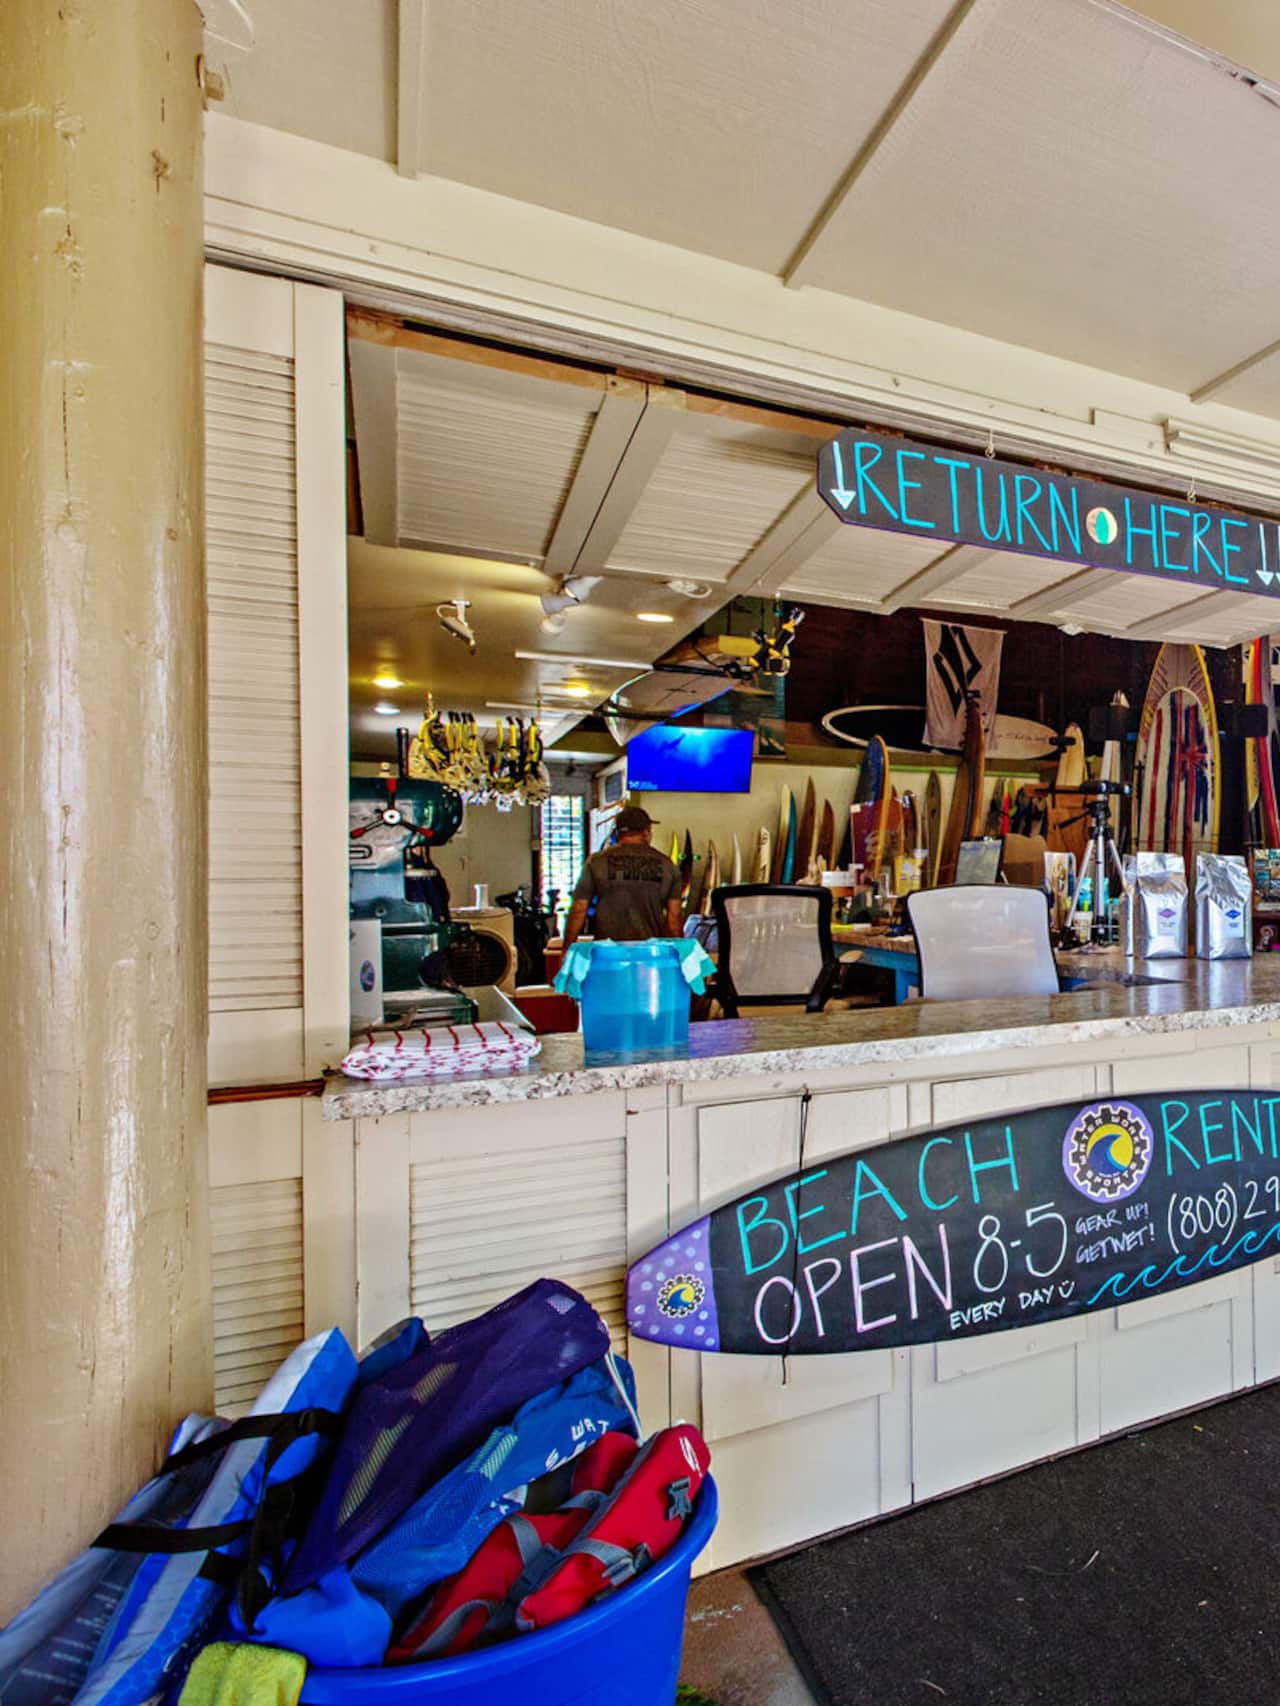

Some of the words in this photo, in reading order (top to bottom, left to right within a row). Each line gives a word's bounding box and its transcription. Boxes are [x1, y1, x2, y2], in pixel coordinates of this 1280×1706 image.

[855, 441, 1082, 556] RETURN
[1125, 497, 1250, 584] HERE
[736, 1125, 1019, 1276] BEACH
[1075, 1209, 1122, 1236] GEAR
[1126, 1202, 1149, 1221] UP!
[1167, 1182, 1238, 1254] (808)
[754, 1223, 953, 1345] OPEN
[973, 1202, 1068, 1293] 8-5
[950, 1298, 1006, 1331] EVERY
[1019, 1287, 1055, 1309] DAY
